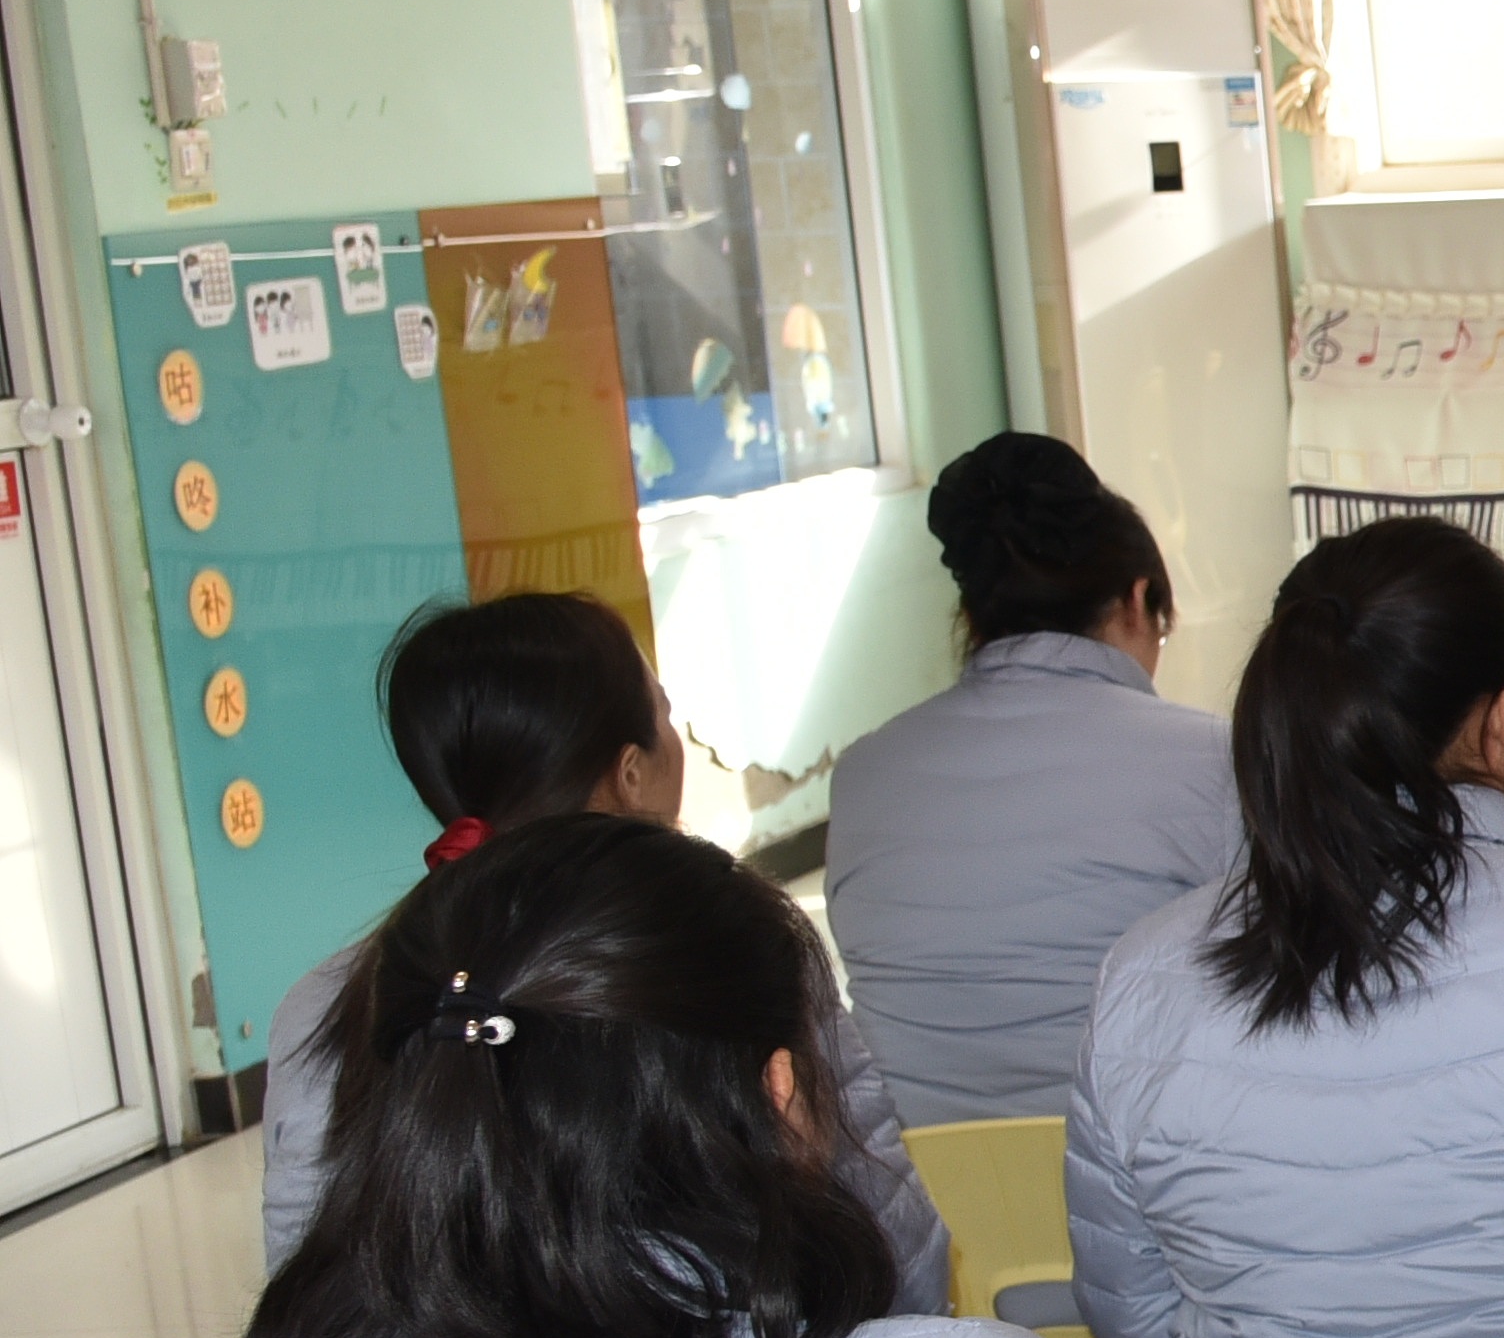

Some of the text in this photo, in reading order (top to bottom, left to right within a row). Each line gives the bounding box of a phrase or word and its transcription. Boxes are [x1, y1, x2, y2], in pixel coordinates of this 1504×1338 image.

[165, 362, 258, 834] 咕咚补水站
